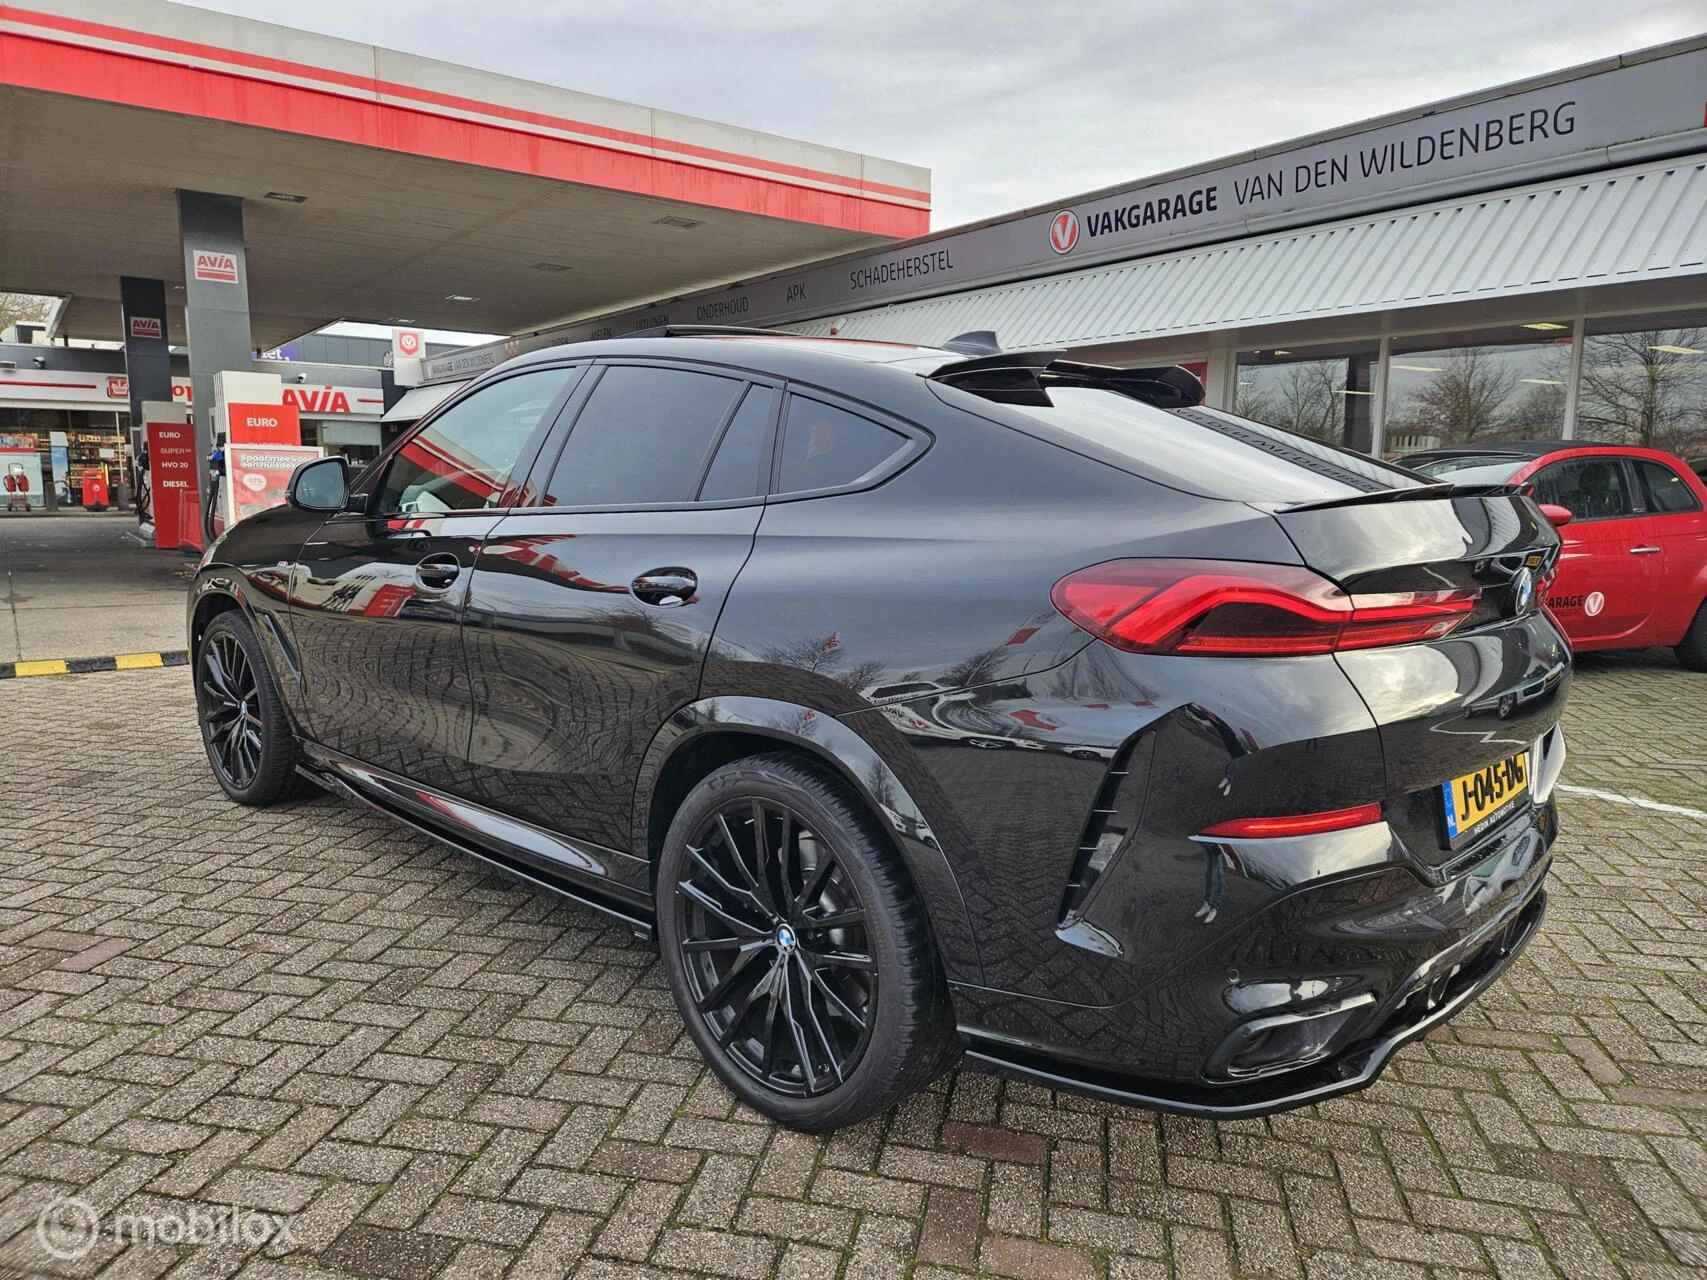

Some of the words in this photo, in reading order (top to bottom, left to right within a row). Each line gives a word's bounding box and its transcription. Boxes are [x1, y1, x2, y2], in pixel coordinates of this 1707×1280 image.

[1087, 185, 1218, 238] VAKGARAGE
[1233, 170, 1284, 206] VAN
[1294, 155, 1348, 193] DEN
[1359, 101, 1577, 179] WILDENBERG
[850, 249, 954, 290] SCHADEHERSTEL
[786, 282, 807, 304] APK
[696, 296, 749, 321] ONDERHOUD
[246, 417, 278, 428] EURO
[158, 431, 181, 439] EURO
[241, 455, 269, 463] Spaar
[162, 480, 189, 488] DIESEL
[1446, 814, 1456, 828] NL
